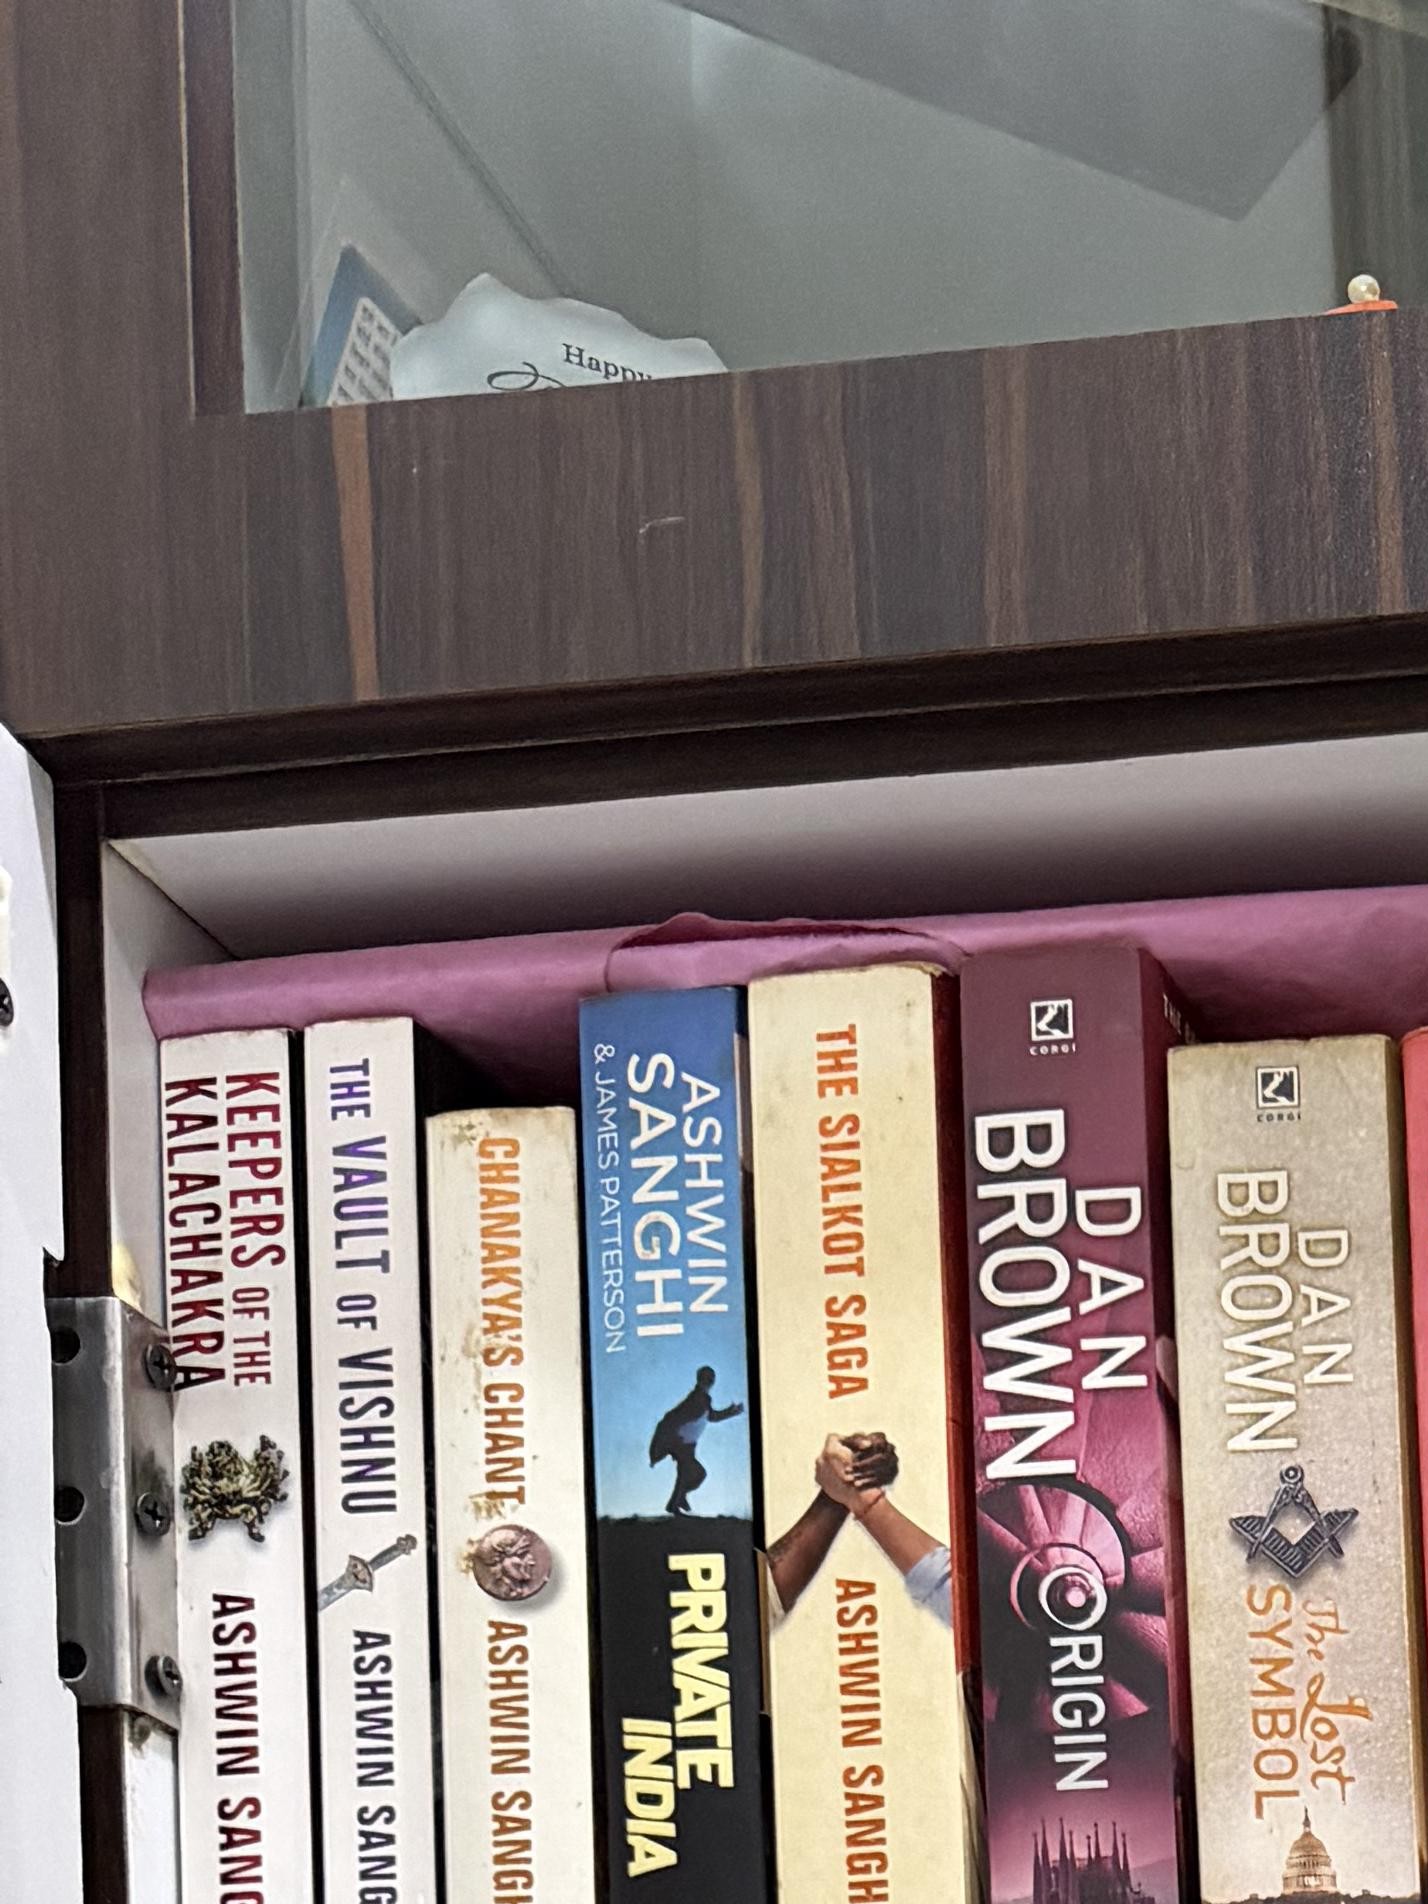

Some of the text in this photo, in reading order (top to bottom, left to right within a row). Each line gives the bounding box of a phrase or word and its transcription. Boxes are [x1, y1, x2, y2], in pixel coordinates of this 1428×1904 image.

[164, 1076, 226, 1393] KALACHAKRA
[224, 1071, 287, 1387] KEEPERS OF THE
[330, 1057, 397, 1515] THE VAULT OF VISHNU
[594, 1041, 625, 1354] & JAMES PATTERSON
[974, 1110, 1076, 1479] BROWN
[1075, 1185, 1147, 1389] DAN
[622, 1717, 677, 1878] INDIA
[667, 1553, 734, 1789] PRIVATE
[1038, 1563, 1109, 1791] ORIGIN
